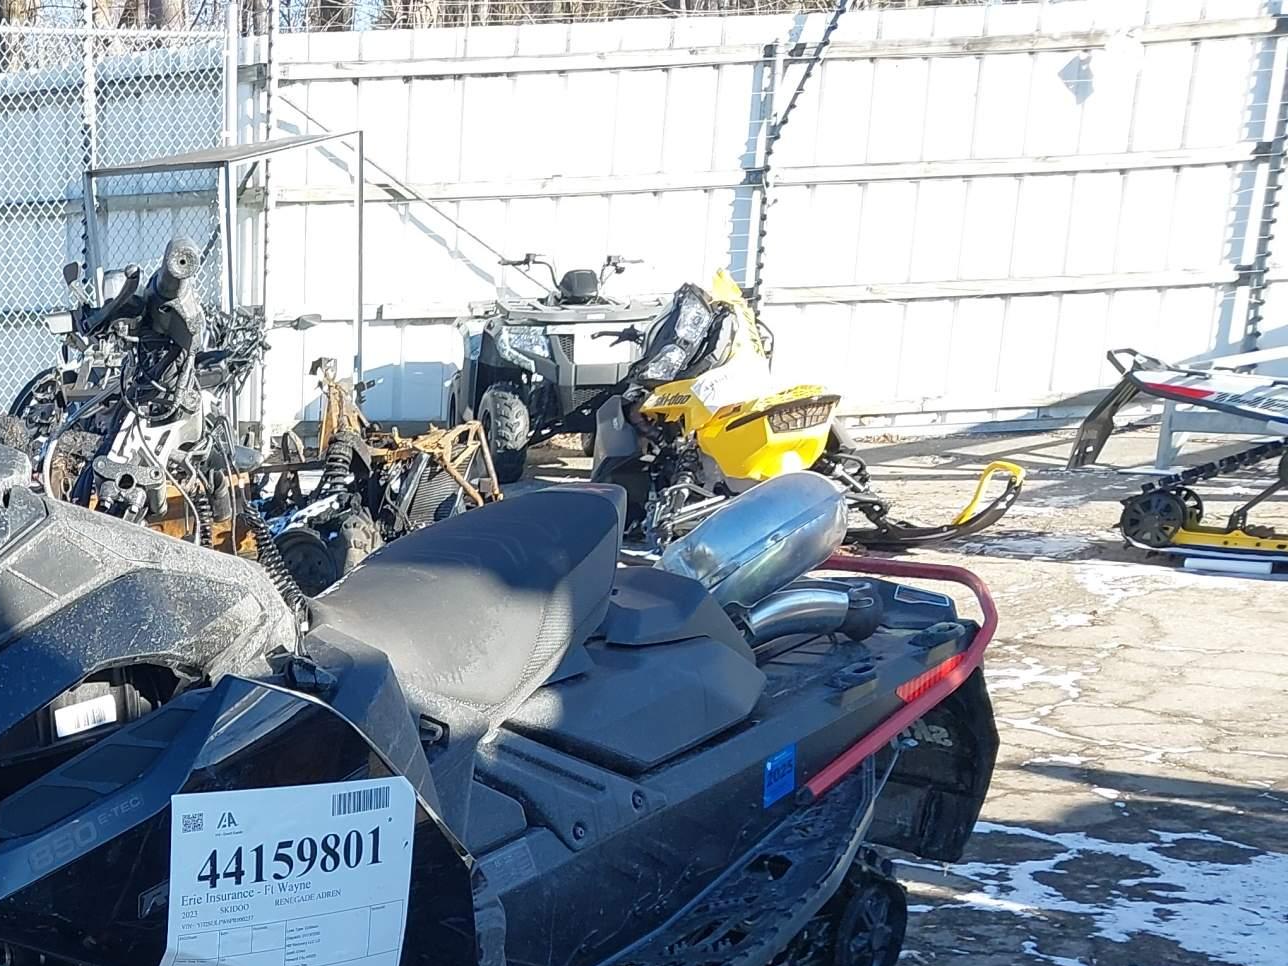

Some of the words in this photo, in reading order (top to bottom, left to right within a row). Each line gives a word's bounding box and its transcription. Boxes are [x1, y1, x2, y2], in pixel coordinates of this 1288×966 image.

[197, 826, 383, 889] 44159801
[181, 893, 203, 906] Erie
[206, 889, 255, 903] Insurance
[278, 881, 312, 894] Wayne
[220, 904, 250, 914] SKIDOO
[275, 894, 315, 906] RENEGADE
